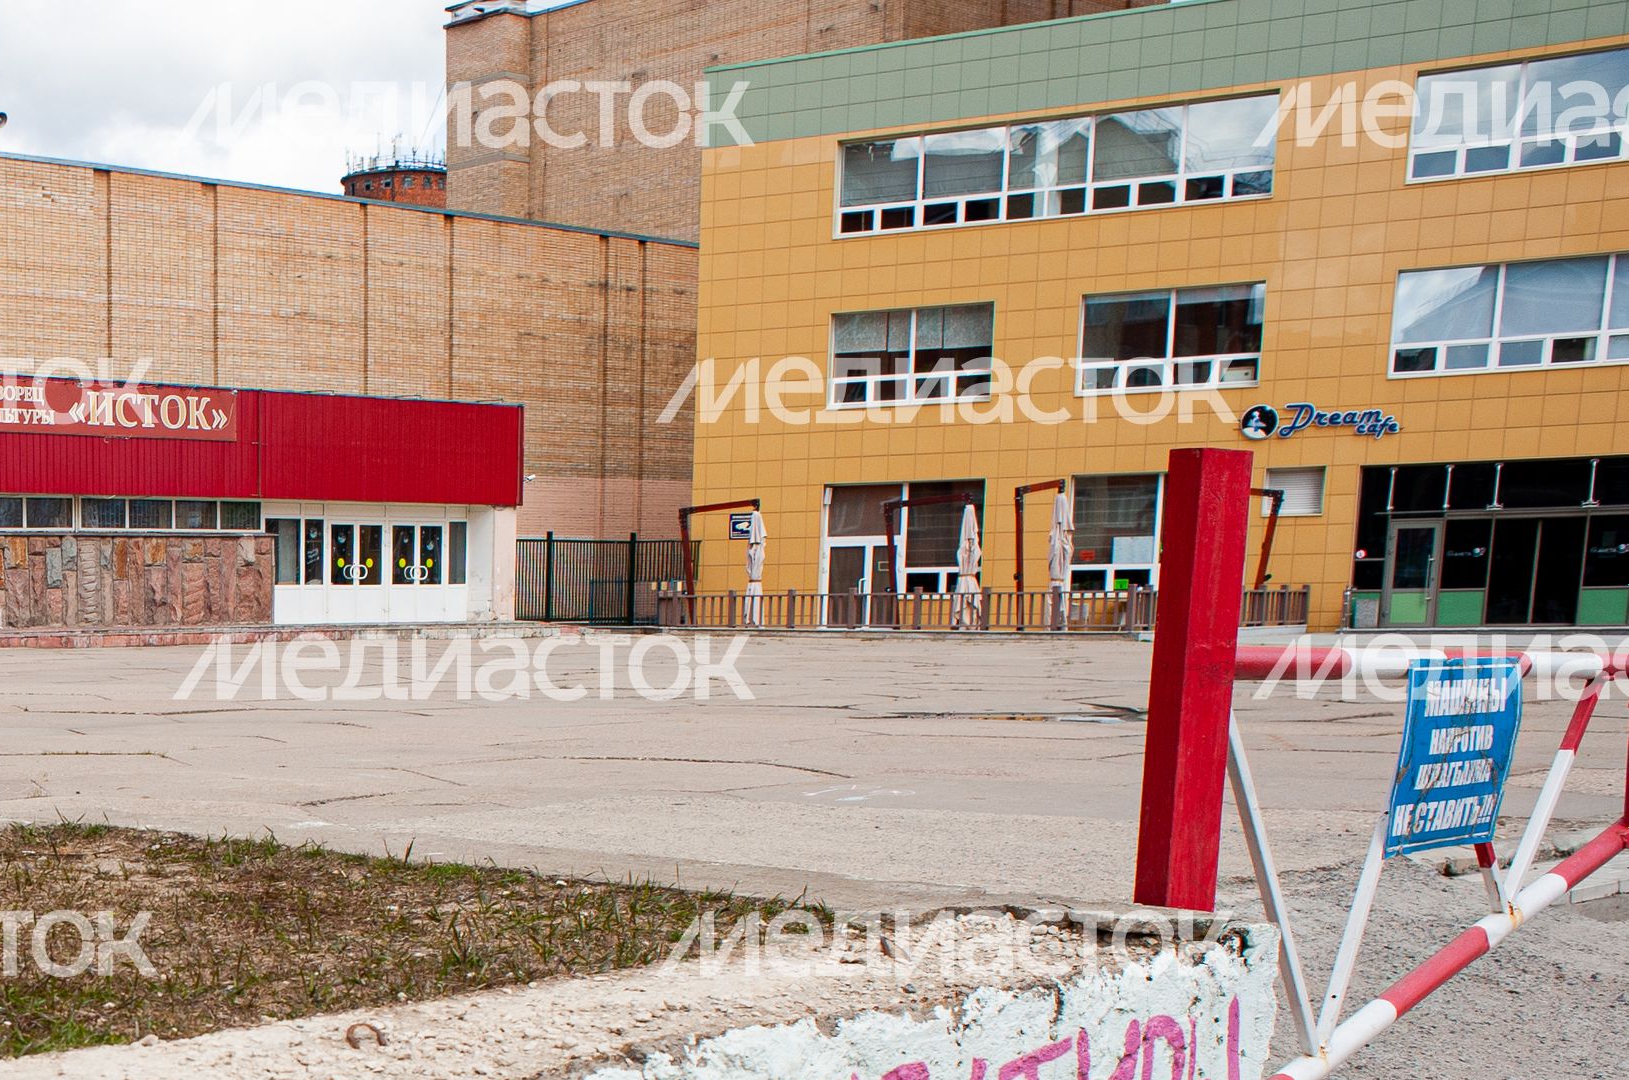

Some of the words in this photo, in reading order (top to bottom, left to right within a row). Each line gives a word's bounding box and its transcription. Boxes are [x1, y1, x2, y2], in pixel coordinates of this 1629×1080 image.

[69, 391, 228, 430] «ИСТОК»
[1278, 402, 1382, 439] Dream
[1354, 416, 1400, 439] cafe
[1392, 803, 1415, 837] НЕ
